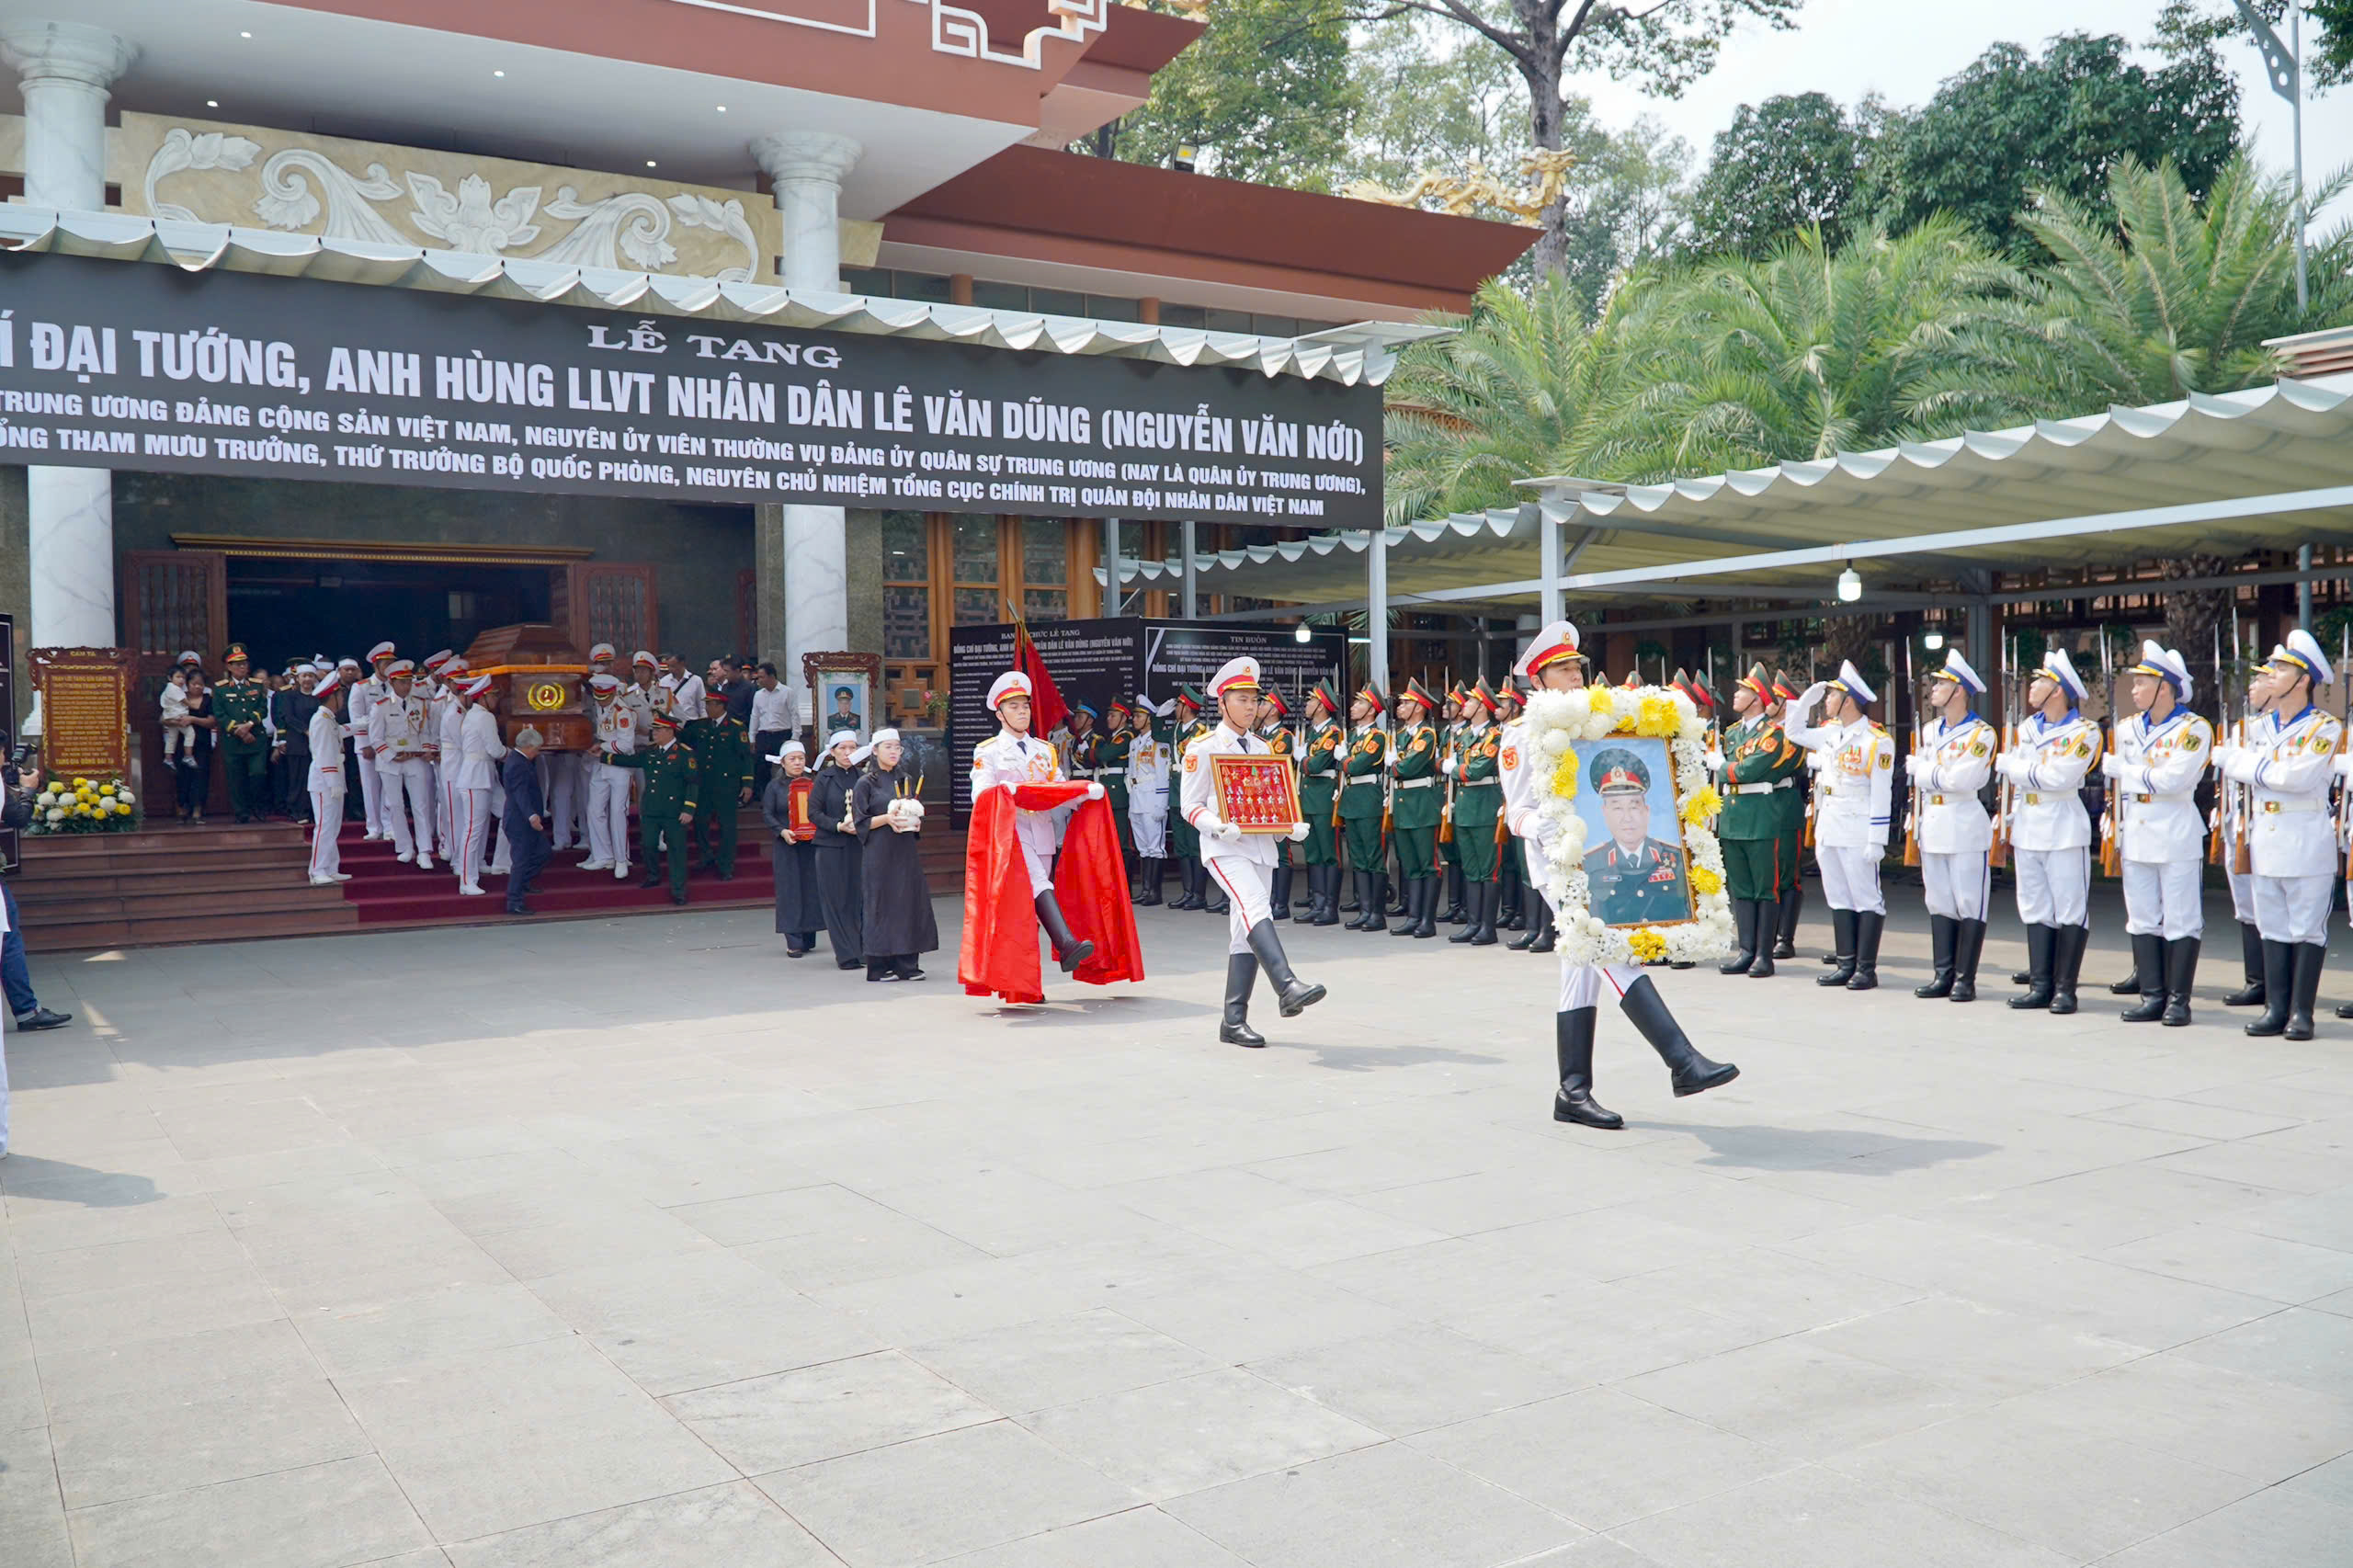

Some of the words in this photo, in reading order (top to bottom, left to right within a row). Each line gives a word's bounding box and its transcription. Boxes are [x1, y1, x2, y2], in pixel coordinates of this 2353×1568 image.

[588, 320, 667, 353] LỄ
[687, 335, 842, 369] TANG
[30, 322, 117, 383] ĐẠI
[132, 327, 310, 394] TƯỚNG,
[325, 347, 421, 397] ANH
[436, 349, 554, 407] HÙNG
[568, 368, 655, 415] LLVT
[667, 372, 775, 423] NHÂN
[788, 379, 862, 429] DÂN
[874, 385, 913, 432] LÊ
[924, 390, 992, 437] VĂN
[1003, 396, 1090, 444] DŨNG
[1102, 403, 1233, 453] (NGUYỄN
[1241, 414, 1298, 458] VĂN
[1307, 420, 1363, 466] NỚI)
[56, 428, 135, 453] THAM
[144, 434, 207, 458] MƯU
[214, 435, 326, 467] TRƯỞNG,
[334, 444, 385, 468] THỨ
[389, 446, 485, 473] TRƯỞNG
[493, 452, 524, 480] BỘ
[531, 454, 592, 480] QUỐC
[598, 460, 680, 486] PHÒNG,
[687, 467, 770, 489] NGUYÊN
[777, 468, 817, 492] CHỦ
[823, 472, 887, 497] NHIỆM
[892, 472, 942, 497] TỔNG
[948, 481, 984, 502] CỤC
[989, 481, 1044, 502] CHÍNH
[1049, 486, 1076, 507] TRỊ
[1081, 485, 1128, 506] QUÂN
[1132, 488, 1160, 510] ĐỘI
[1165, 490, 1211, 509] NHÂN
[1215, 492, 1248, 511] DÂN
[1252, 494, 1285, 517] VIỆT
[1289, 498, 1324, 516] NAM
[92, 394, 167, 421] ƯƠNG
[175, 396, 250, 426] ĐẢNG
[258, 404, 329, 433] CỘNG
[337, 408, 390, 436] SẢN
[396, 415, 449, 442] VIỆT
[455, 421, 517, 446] NAM,
[525, 426, 616, 450] NGUYÊN
[623, 426, 651, 452] ỦY
[656, 433, 706, 456] VIÊN
[711, 437, 794, 460] THƯỜNG
[800, 444, 825, 466] VỤ
[831, 441, 885, 466] ĐẢNG
[891, 444, 915, 468] ỦY
[920, 449, 971, 471] QUÂN
[976, 454, 1003, 476] SỰ
[1006, 456, 1063, 476] TRUNG
[1069, 459, 1116, 479] ƯƠNG
[1121, 463, 1159, 482] (NAY
[1164, 463, 1184, 483] LÀ
[1188, 465, 1233, 485] QUÂN
[1236, 465, 1256, 486] ỦY
[1260, 472, 1311, 490] TRUNG
[1314, 474, 1366, 495] ƯƠNG),
